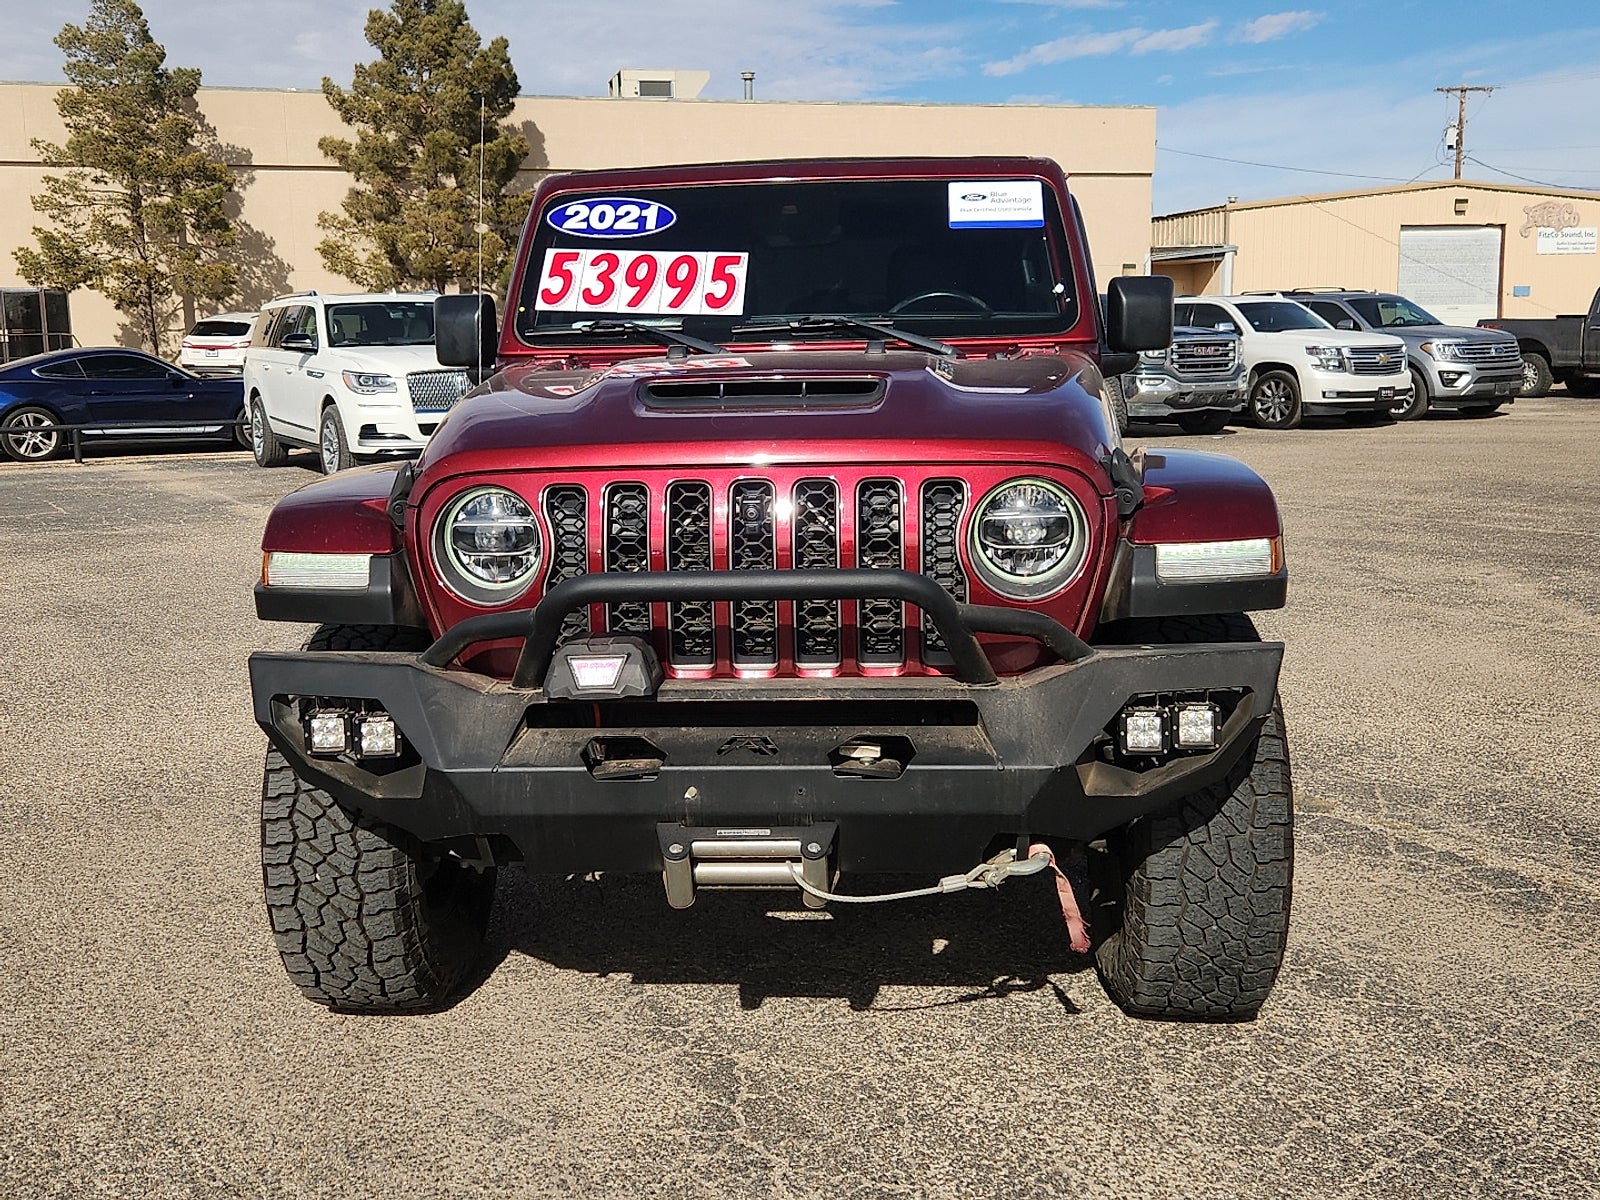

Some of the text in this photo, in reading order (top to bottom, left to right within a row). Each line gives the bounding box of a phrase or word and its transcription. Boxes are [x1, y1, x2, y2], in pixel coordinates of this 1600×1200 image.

[561, 204, 660, 231] 2021
[540, 252, 744, 310] 53995
[1193, 346, 1222, 356] GMC
